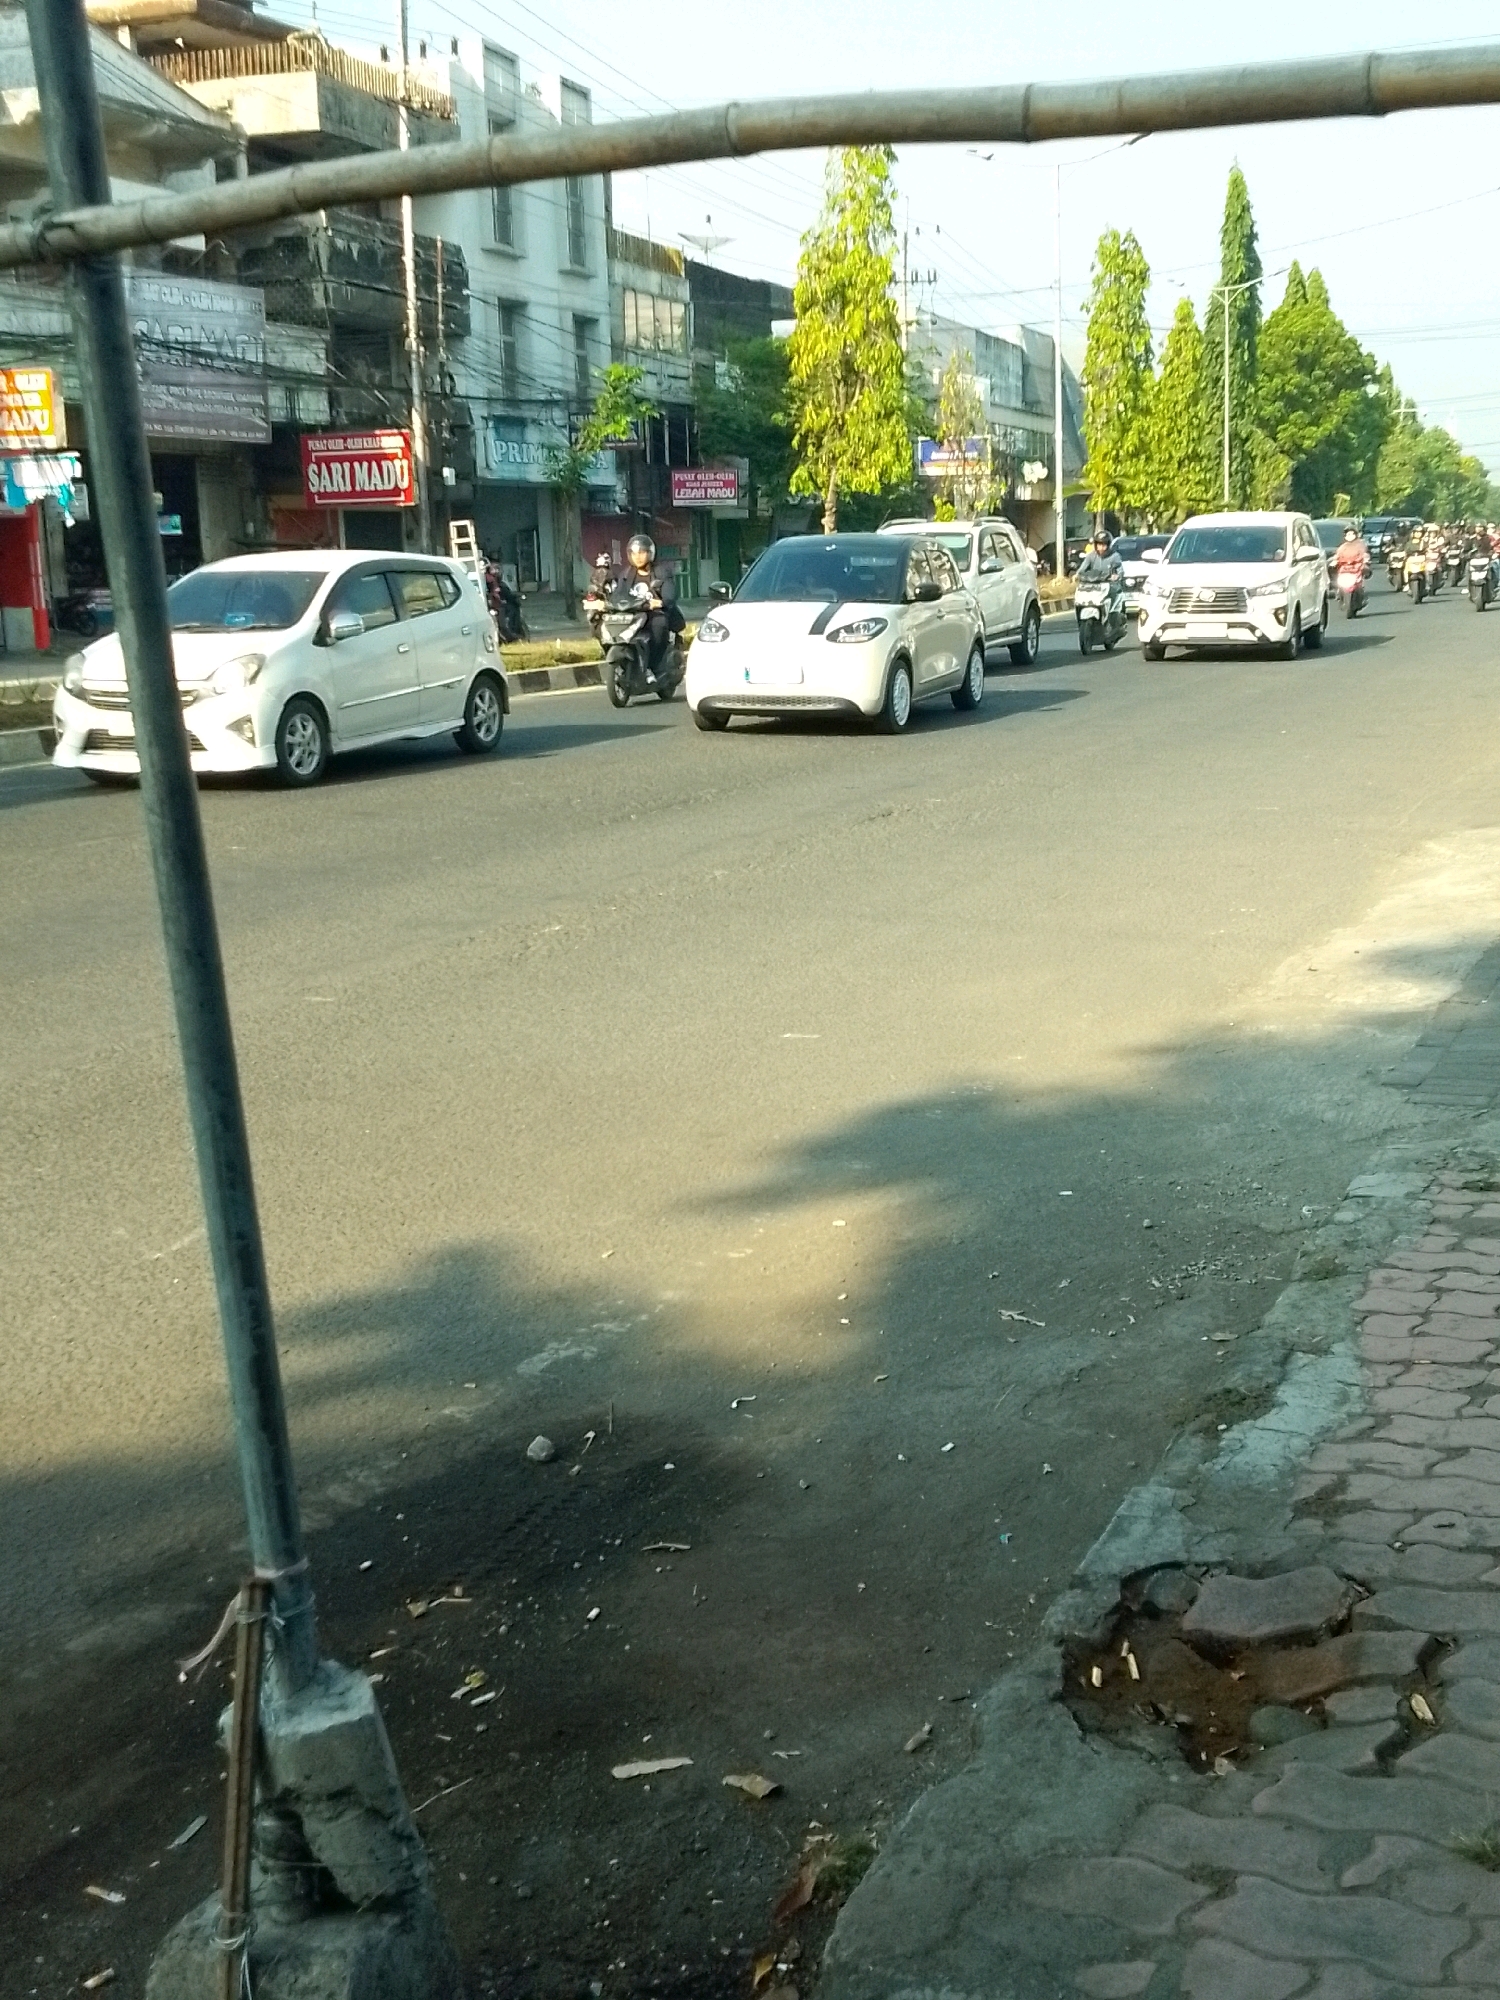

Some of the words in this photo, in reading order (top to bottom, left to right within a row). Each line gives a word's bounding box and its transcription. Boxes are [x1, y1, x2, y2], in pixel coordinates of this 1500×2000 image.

[307, 461, 352, 494] SARI
[353, 458, 409, 491] MADU
[674, 487, 706, 499] LEBAH
[706, 487, 735, 499] MADU
